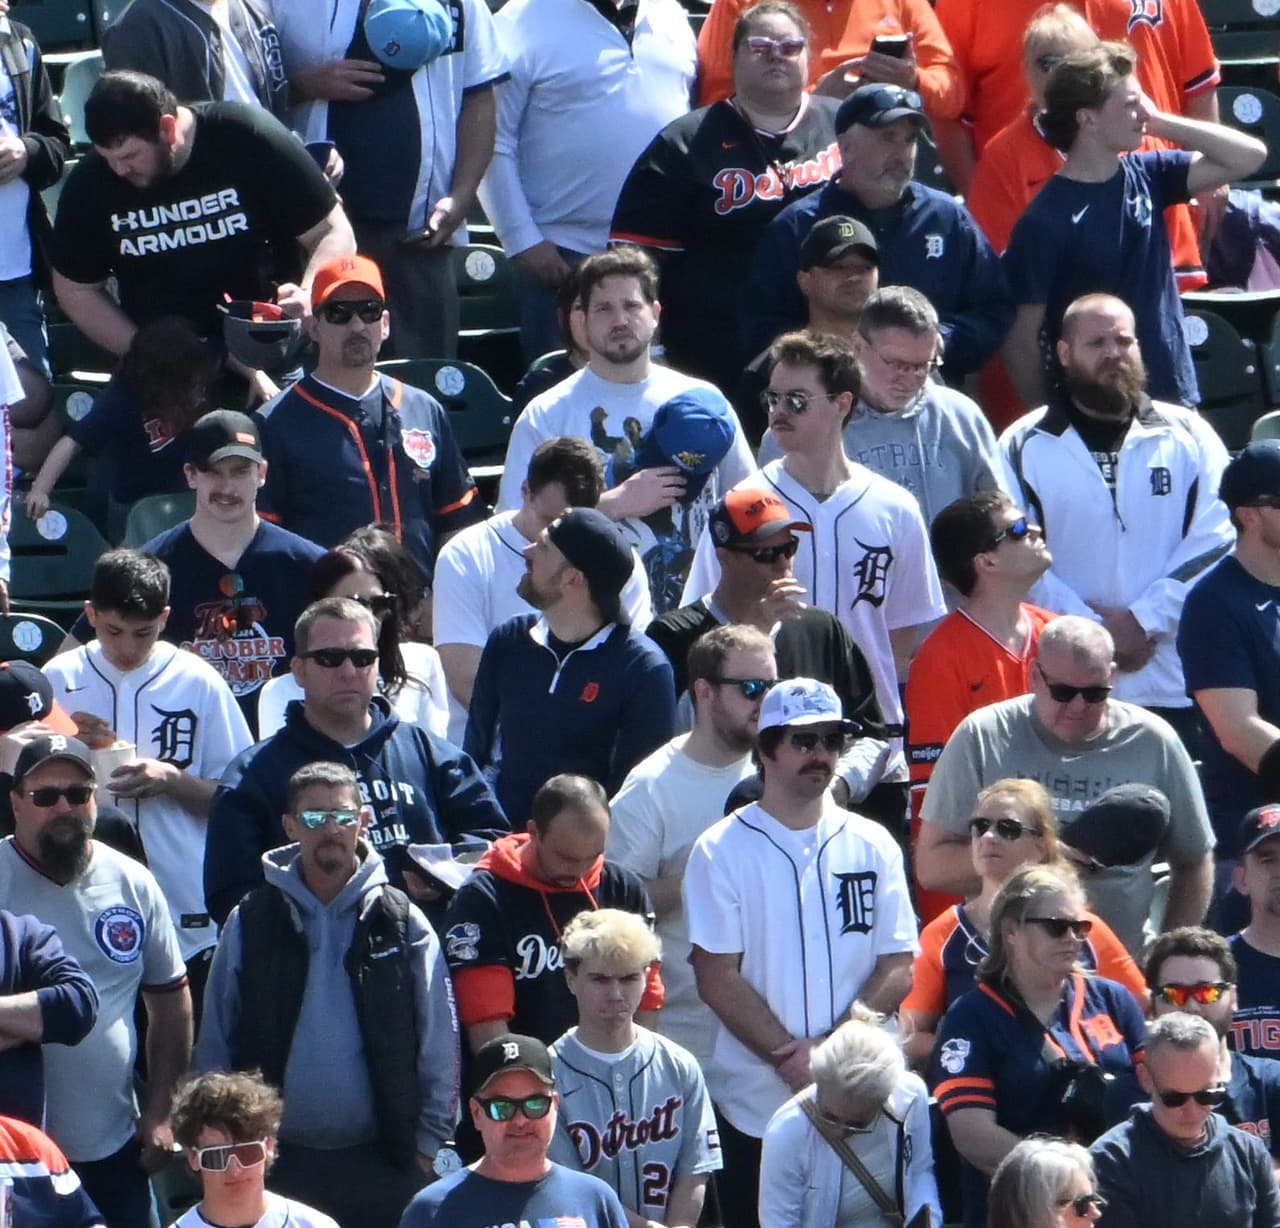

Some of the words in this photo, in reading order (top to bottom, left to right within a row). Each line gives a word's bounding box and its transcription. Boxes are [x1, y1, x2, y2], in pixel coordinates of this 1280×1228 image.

[139, 188, 240, 229] UNDER
[120, 211, 249, 257] ARMOUR
[925, 234, 945, 260] D
[857, 441, 945, 468] ETROIT
[1149, 467, 1172, 496] D
[851, 536, 893, 610] D
[203, 656, 277, 682] EADY
[25, 692, 43, 714] D
[50, 735, 67, 753] D
[150, 703, 198, 770] D
[833, 870, 877, 936] D
[502, 1042, 520, 1064] D
[568, 1096, 683, 1171] Detroit
